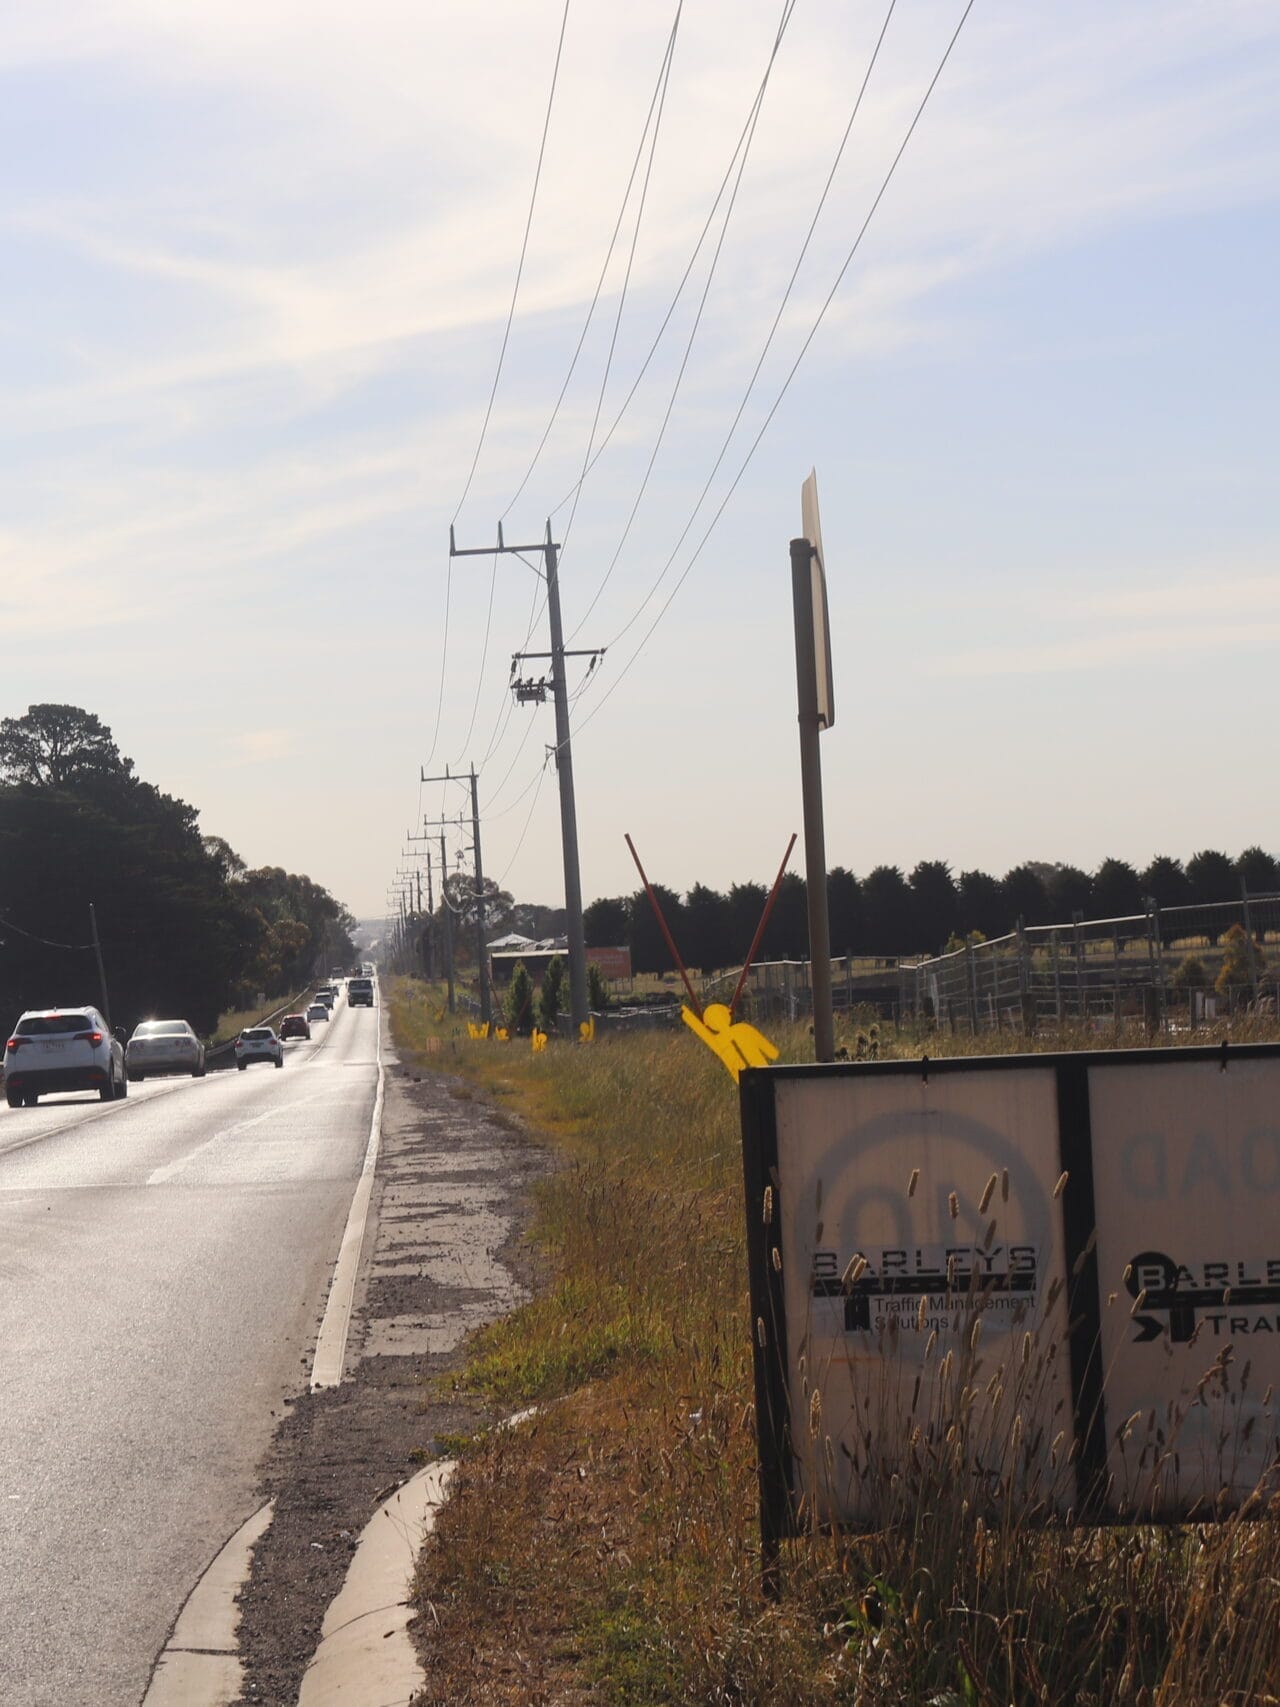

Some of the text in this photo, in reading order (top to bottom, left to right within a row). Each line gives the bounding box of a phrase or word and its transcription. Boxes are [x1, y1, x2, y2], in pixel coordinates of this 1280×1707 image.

[929, 1294, 1036, 1313] Mnement
[874, 1315, 949, 1330] Slutons
[1205, 1314, 1280, 1335] TRA
